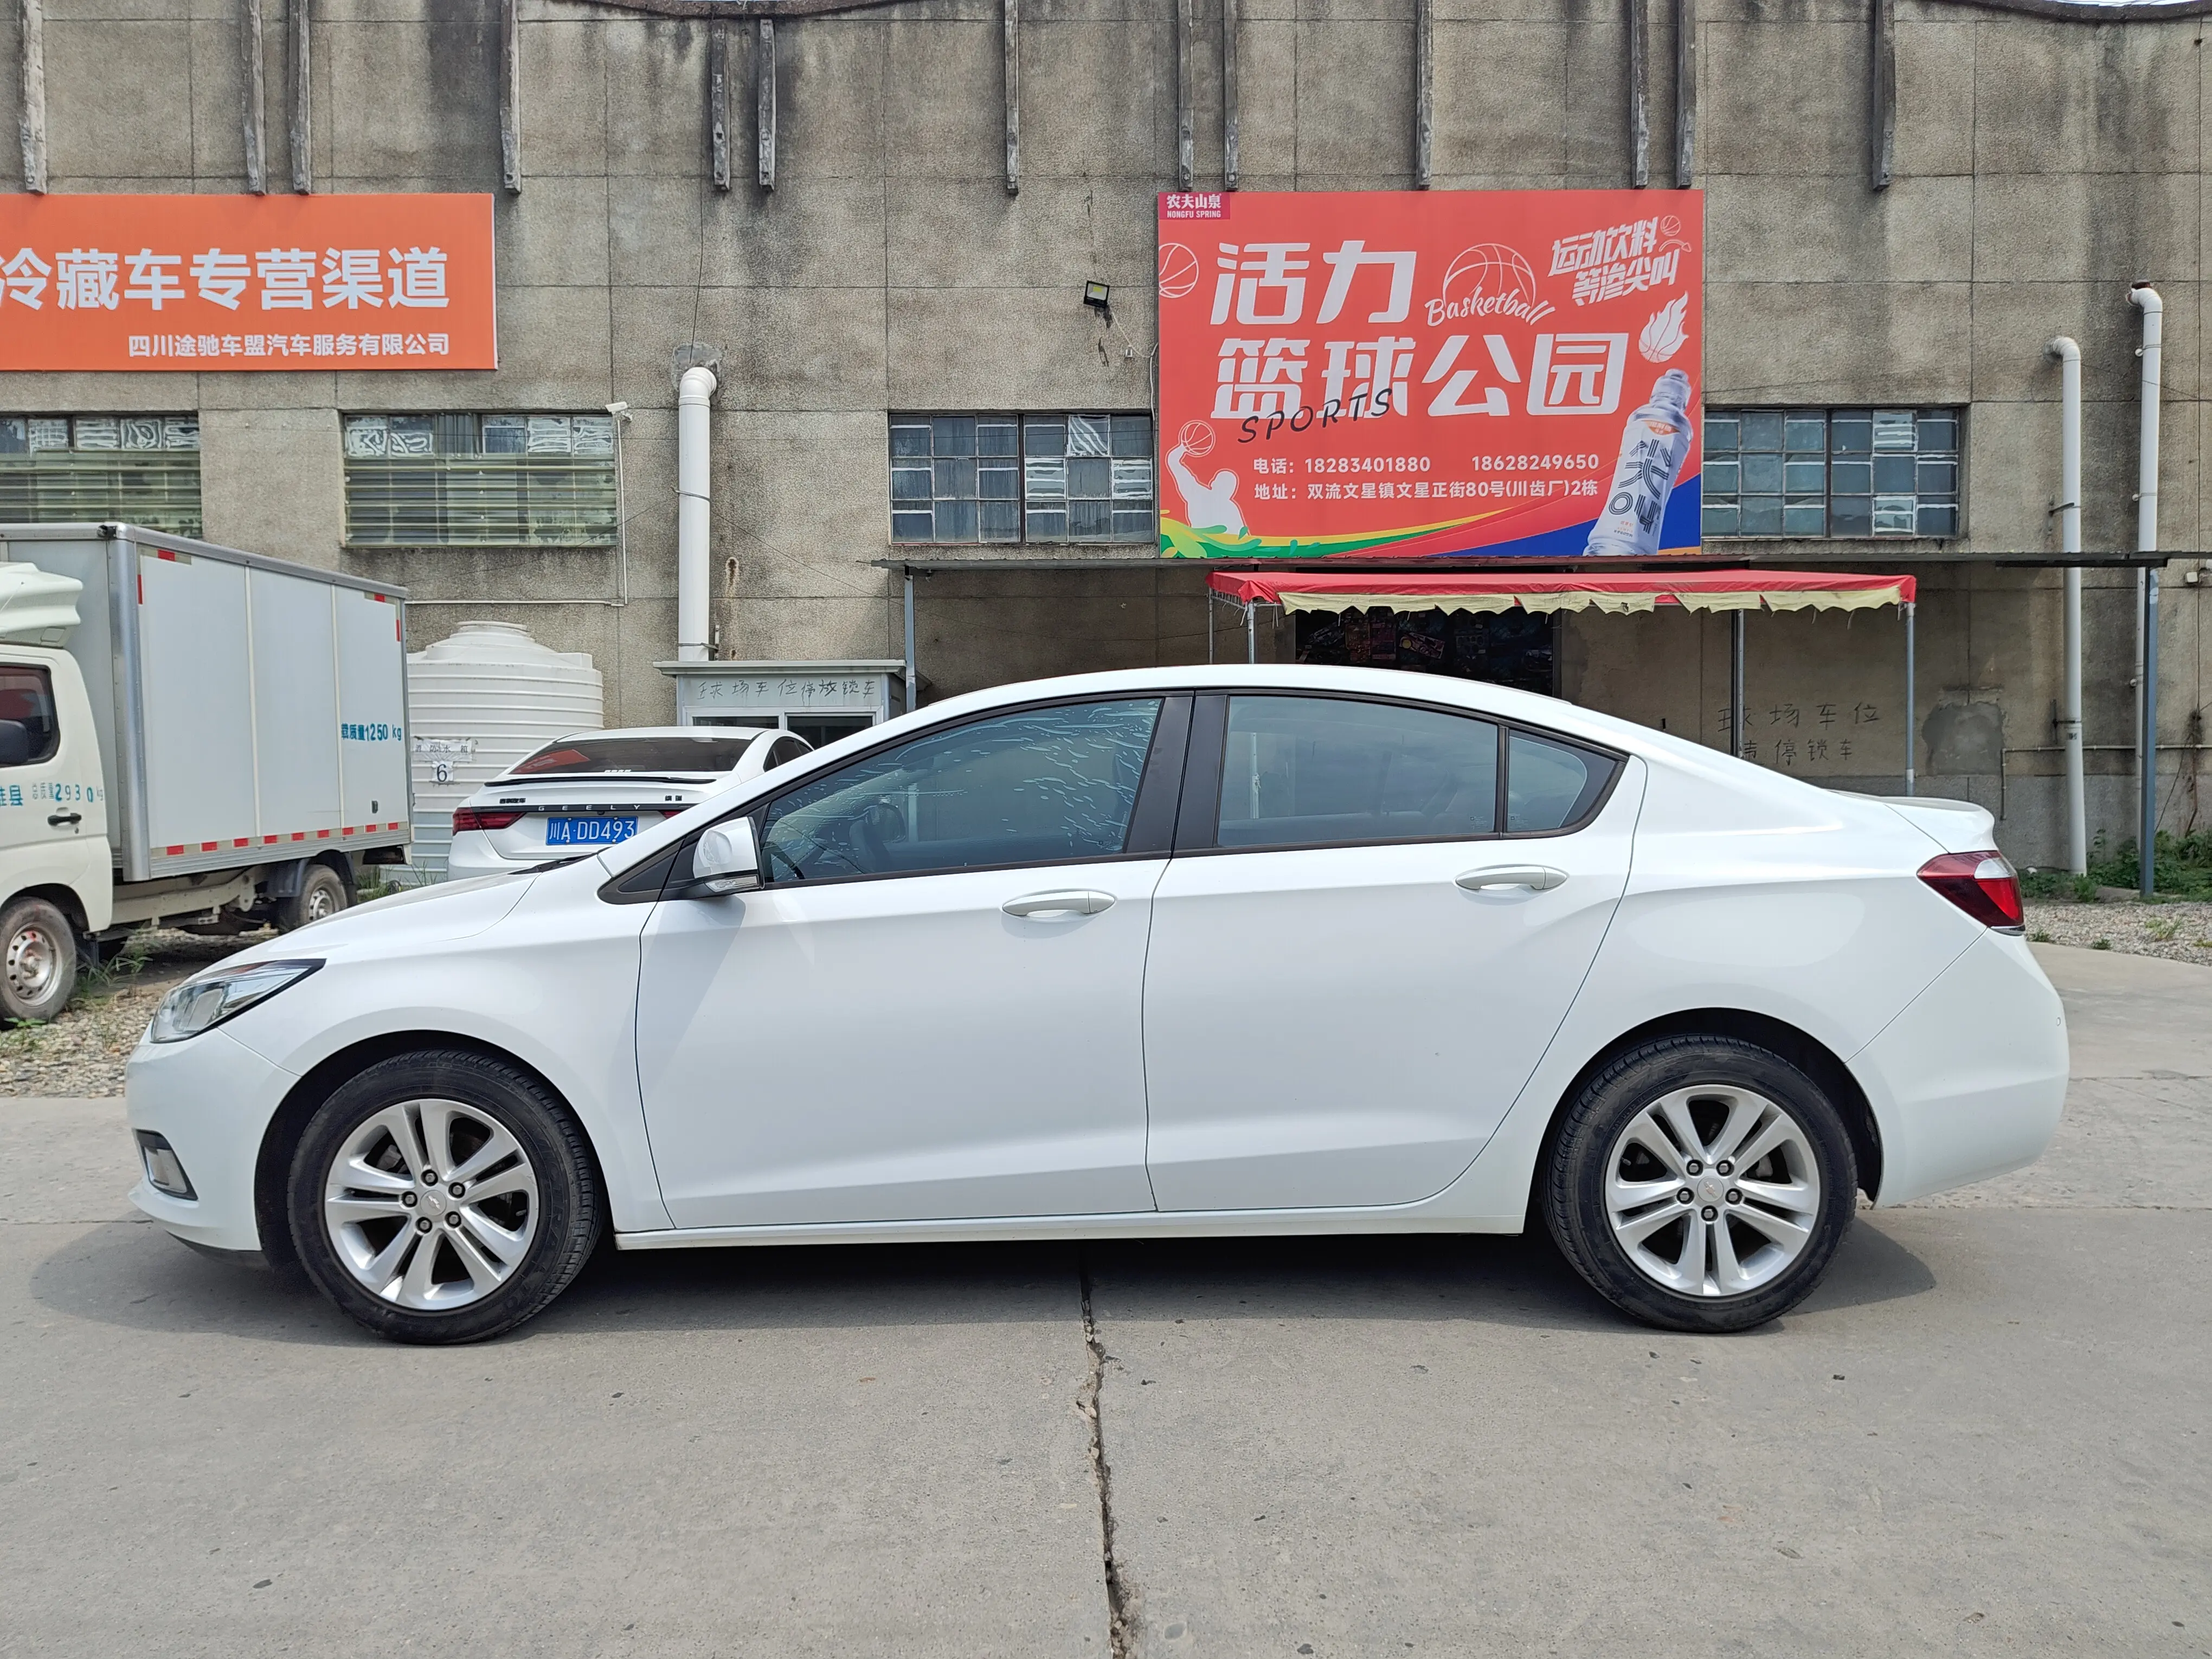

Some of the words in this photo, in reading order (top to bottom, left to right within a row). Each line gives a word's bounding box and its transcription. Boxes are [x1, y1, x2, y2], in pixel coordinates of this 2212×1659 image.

[1166, 194, 1221, 209] 农夫山泉
[1547, 216, 1658, 277] 运动饮料
[0, 247, 449, 311] 冷藏车专营渠道
[1210, 240, 1417, 325] 活力
[1572, 248, 1680, 306] 等渗尖叫
[1424, 286, 1556, 326] Basketball
[128, 333, 449, 357] 四川途驰车盟汽车服务有限公司
[1210, 332, 1629, 420] 篮球公园
[1237, 388, 1393, 443] SPORTS
[1472, 454, 1599, 471] 18628249650
[437, 764, 448, 782] 6
